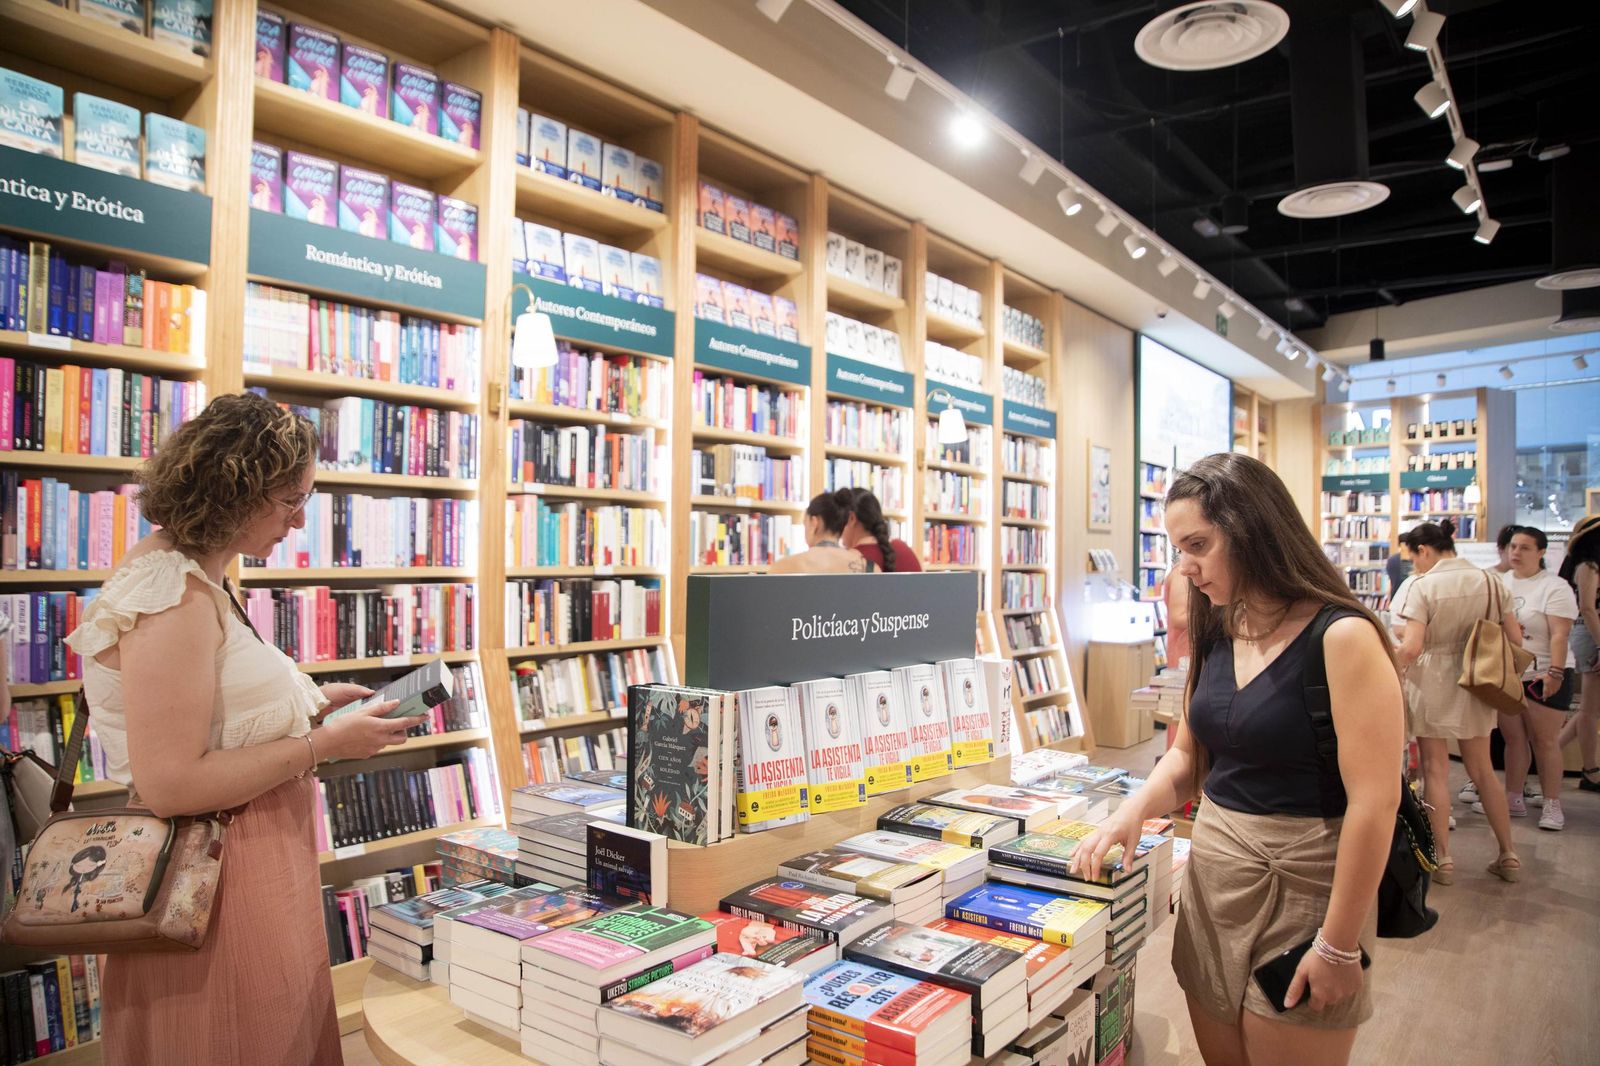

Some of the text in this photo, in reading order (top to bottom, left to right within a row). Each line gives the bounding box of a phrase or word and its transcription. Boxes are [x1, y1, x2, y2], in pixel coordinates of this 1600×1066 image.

[19, 100, 38, 114] LA
[3, 119, 52, 141] CARTA
[86, 141, 131, 160] CARTA
[54, 191, 69, 211] y
[71, 190, 145, 224] Erótica
[305, 244, 443, 289] Romántica y Erótica
[534, 297, 657, 336] Autores Contemporáneos
[708, 337, 799, 369] Autores Contemporáneos
[791, 611, 930, 642] Policíaca y Suspense
[910, 721, 949, 744] LA ASISTENTA
[953, 712, 989, 732] LA ASISTENTA
[662, 735, 678, 743] Gabriel
[864, 731, 908, 755] LA ASISTENTA
[669, 755, 682, 763] AÑOS
[811, 744, 861, 770] LA ASISTENTA
[659, 767, 681, 775] SOLEDAD
[748, 756, 805, 785] LA ASISTENTA
[827, 765, 851, 781] TE VIGILA
[595, 845, 625, 862] Joël Dicker
[595, 857, 602, 866] Un
[603, 862, 618, 871] animal
[731, 905, 824, 939] TRAS LA PUERTA FREIDA McFADDEN
[953, 908, 960, 918] LA
[962, 910, 988, 925] ASISTENTA
[1009, 921, 1028, 935] FREIDA
[607, 981, 628, 1000] UKETSU
[627, 972, 651, 991] STRANGE
[650, 962, 674, 980] PICTURES
[819, 969, 863, 996] ¿PUEDES
[865, 988, 897, 1005] ESTE
